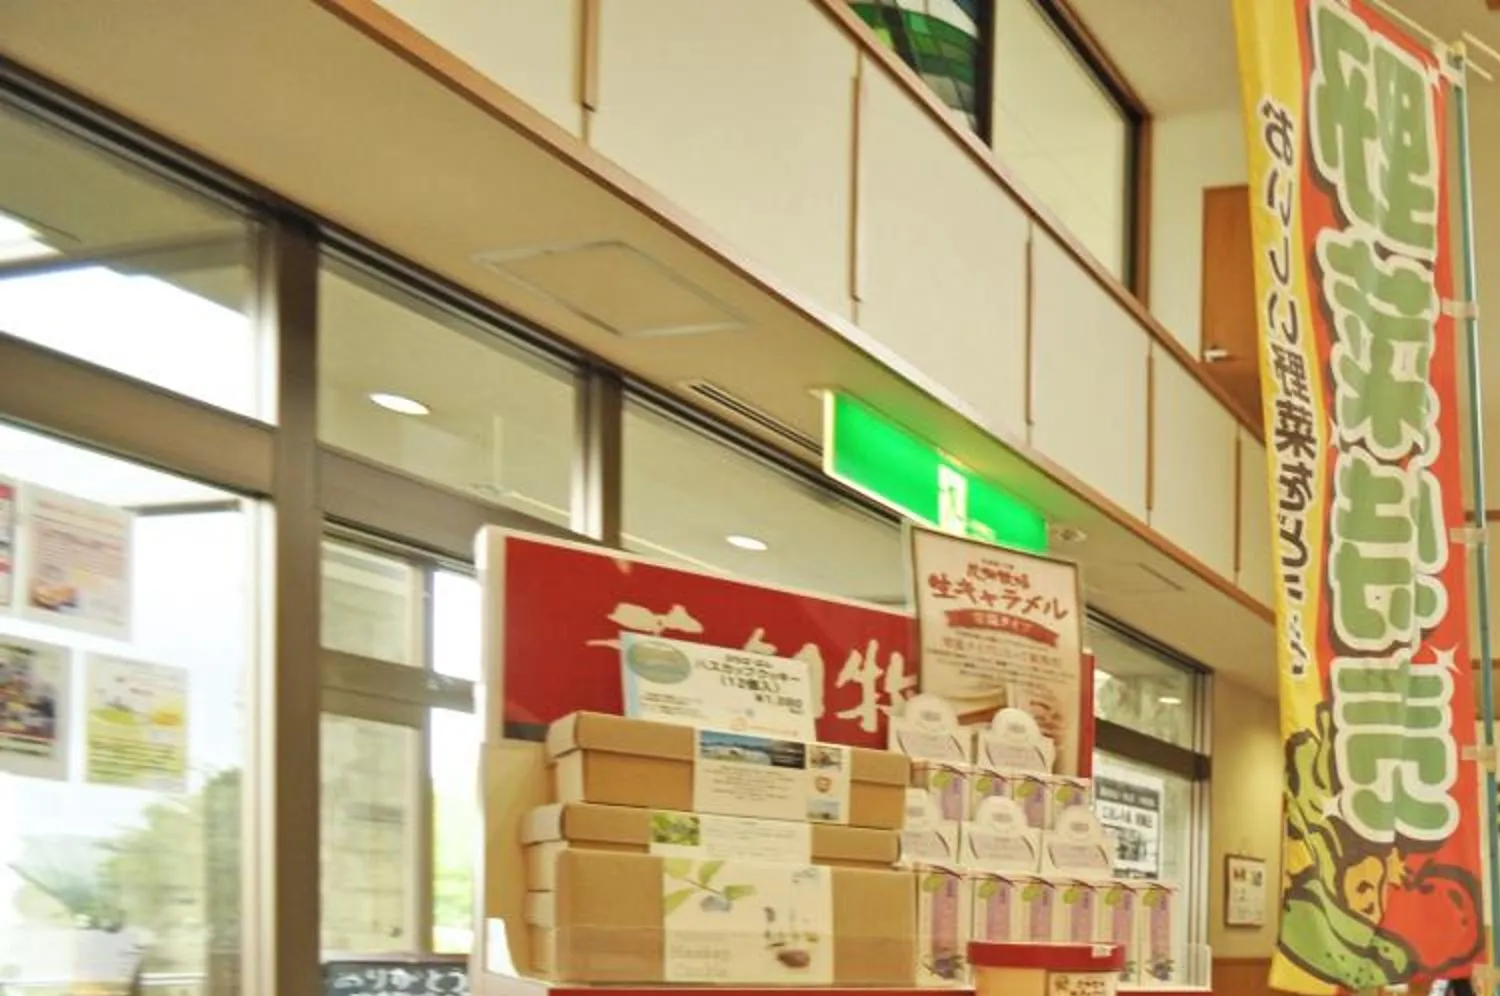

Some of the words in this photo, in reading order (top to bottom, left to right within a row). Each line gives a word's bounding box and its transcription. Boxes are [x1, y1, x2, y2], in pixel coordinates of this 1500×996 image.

[927, 572, 1068, 620] 生キャラメル
